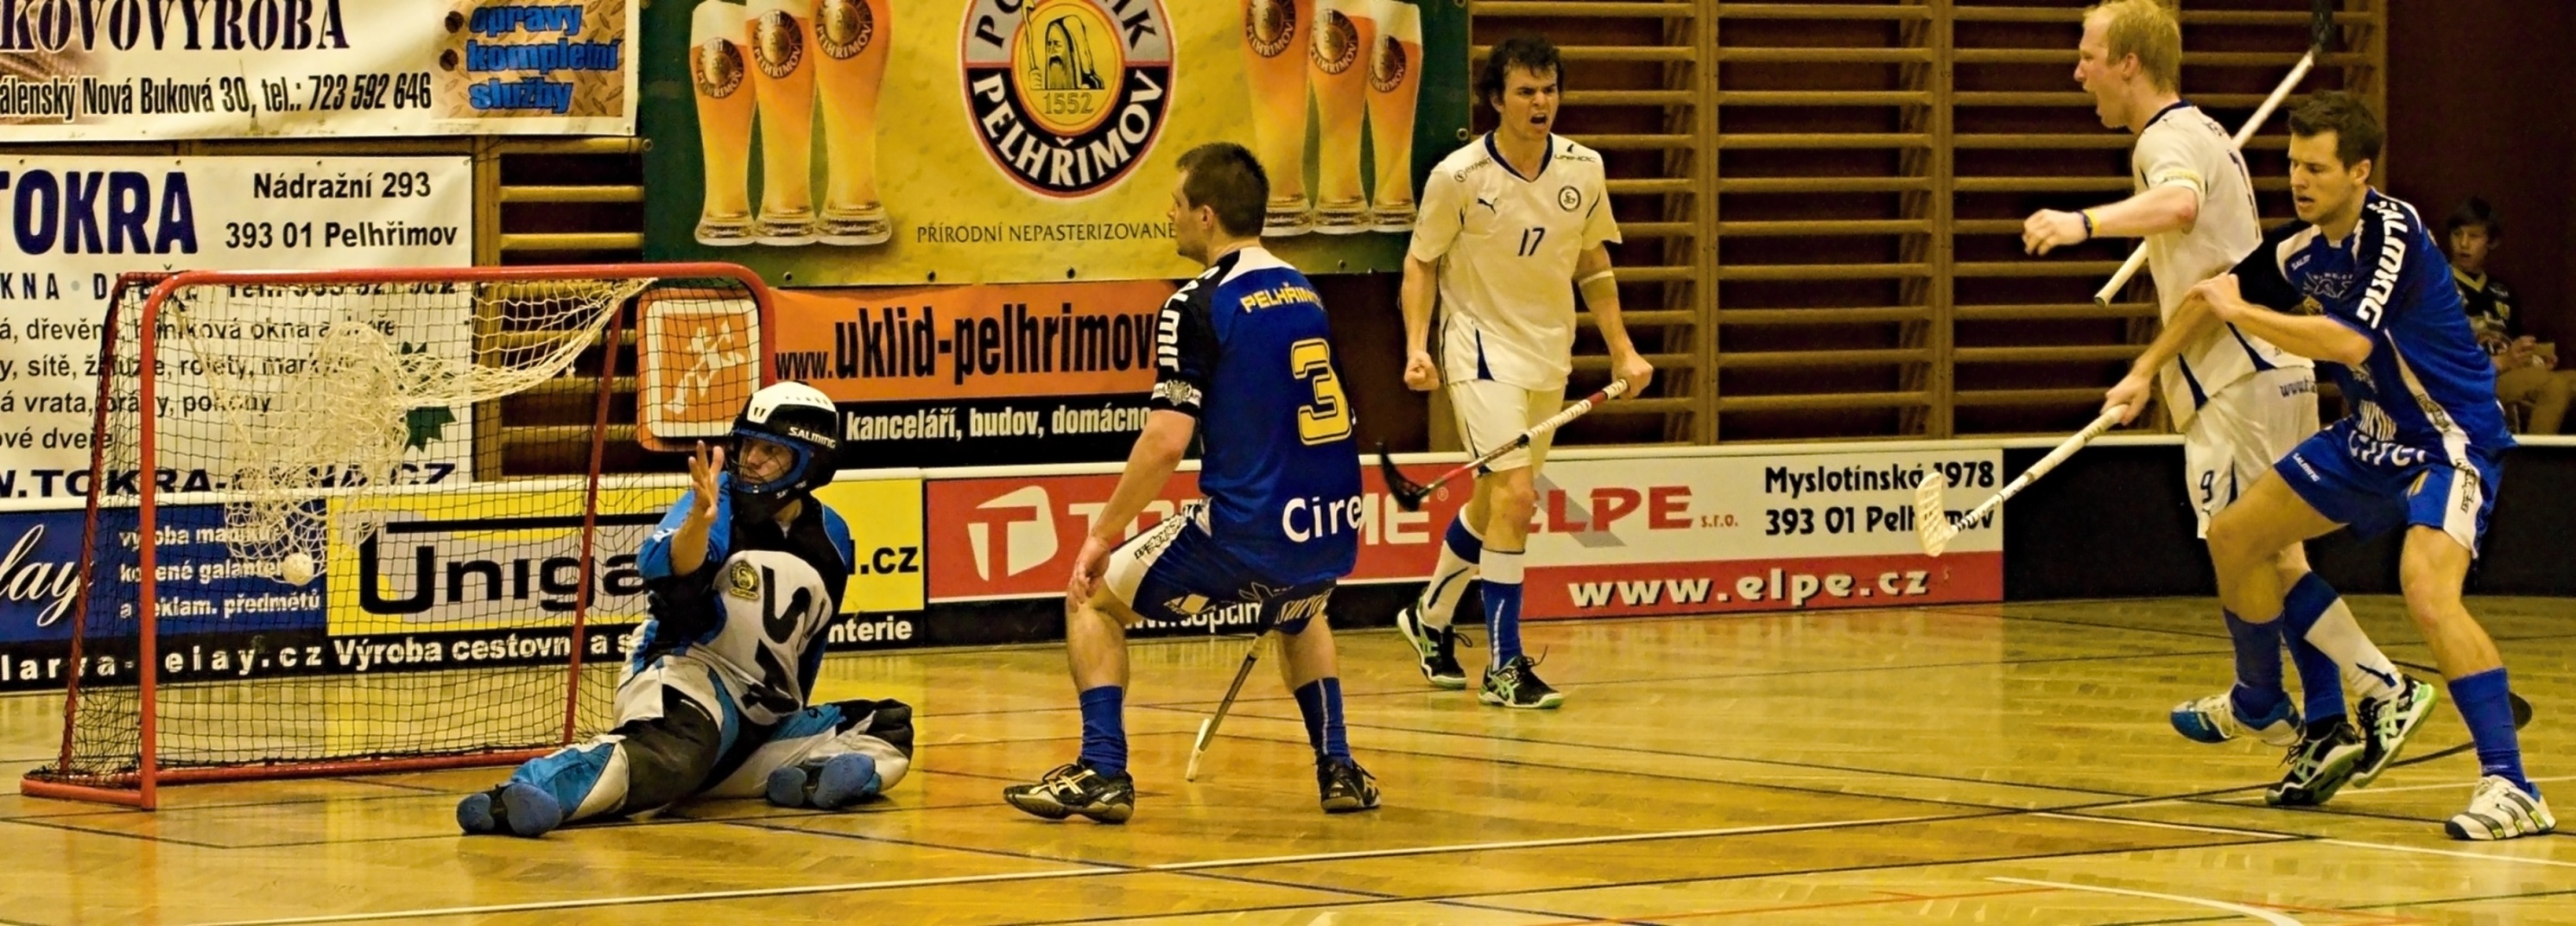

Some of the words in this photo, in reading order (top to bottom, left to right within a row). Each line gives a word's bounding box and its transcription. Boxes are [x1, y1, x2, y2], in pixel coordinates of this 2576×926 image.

[469, 5, 584, 37] opravy
[466, 37, 623, 74] kompletní
[83, 77, 133, 115] Nová
[141, 77, 215, 114] Buková
[219, 76, 256, 117] 30,
[261, 76, 301, 111] tel.:
[308, 74, 347, 111] 723
[350, 73, 389, 110] 592
[393, 72, 432, 110] 646
[468, 77, 573, 114] služby
[1043, 92, 1094, 115] 1552
[973, 69, 1164, 187] PELHŘIMOV
[253, 172, 373, 199] Nádražní
[382, 172, 431, 198] 293
[225, 221, 274, 249] 393
[282, 222, 312, 248] 01
[325, 220, 458, 248] Pelhřimov
[917, 222, 1003, 243] PŘÍRODNÍ
[1518, 227, 1546, 257] 17
[28, 354, 77, 379] sítě,
[24, 392, 92, 415] vrata,
[788, 426, 836, 449] SALMING
[846, 407, 963, 441] kanceláří,
[969, 407, 1044, 438] budov,
[1765, 463, 1924, 498] Myslotínská
[2292, 452, 2320, 482] SALMING
[1701, 514, 1738, 529] s.r.o.
[1765, 508, 1814, 536] 393
[1826, 506, 1855, 534] 01
[119, 526, 189, 550] výoba
[120, 560, 193, 583] koené
[1567, 566, 1931, 608] www.elpe.cz
[152, 597, 217, 618] eklam.
[224, 589, 320, 619] předmětů
[334, 637, 442, 670] Výroba
[452, 631, 577, 662] cestovn
[591, 634, 608, 654] a
